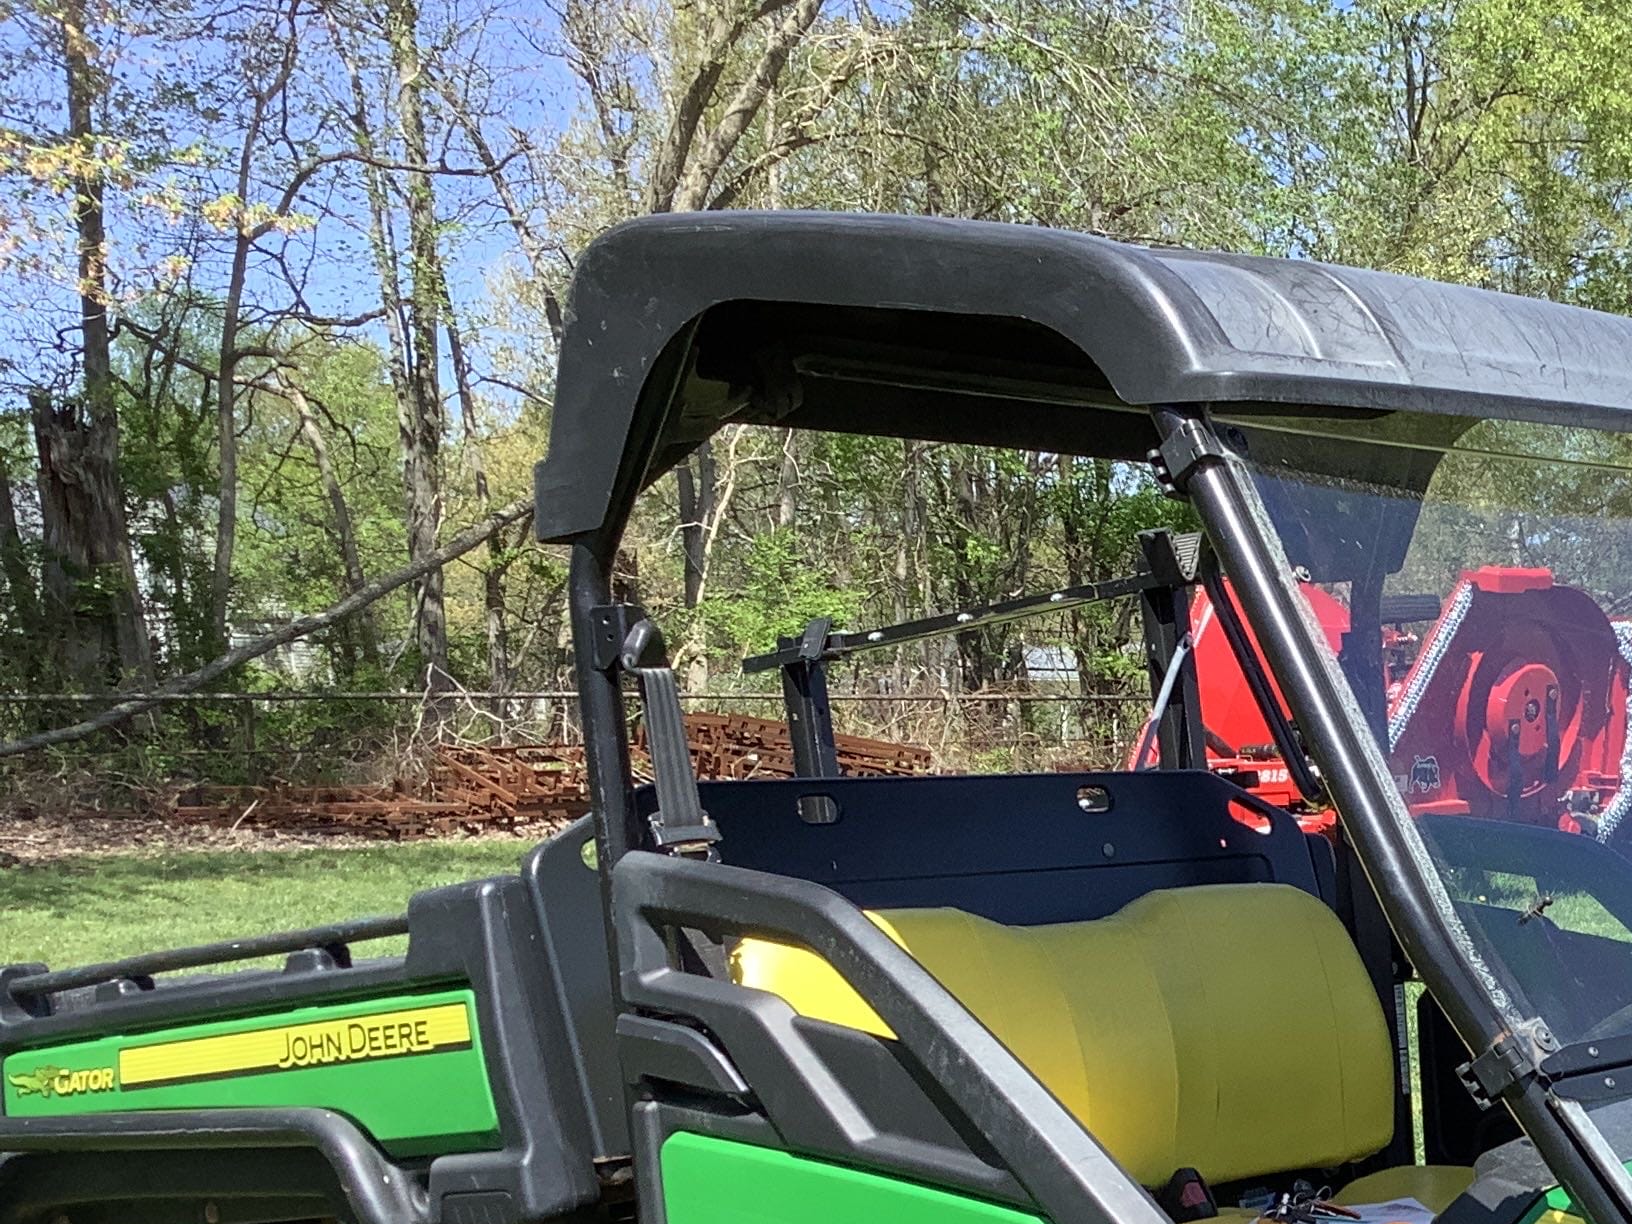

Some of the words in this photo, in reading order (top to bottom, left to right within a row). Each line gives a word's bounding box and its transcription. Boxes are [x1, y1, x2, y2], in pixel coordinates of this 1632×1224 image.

[1257, 768, 1289, 783] 815
[280, 1021, 343, 1064] JOHN
[348, 1020, 430, 1054] DEERE
[54, 1067, 115, 1095] GATOR
